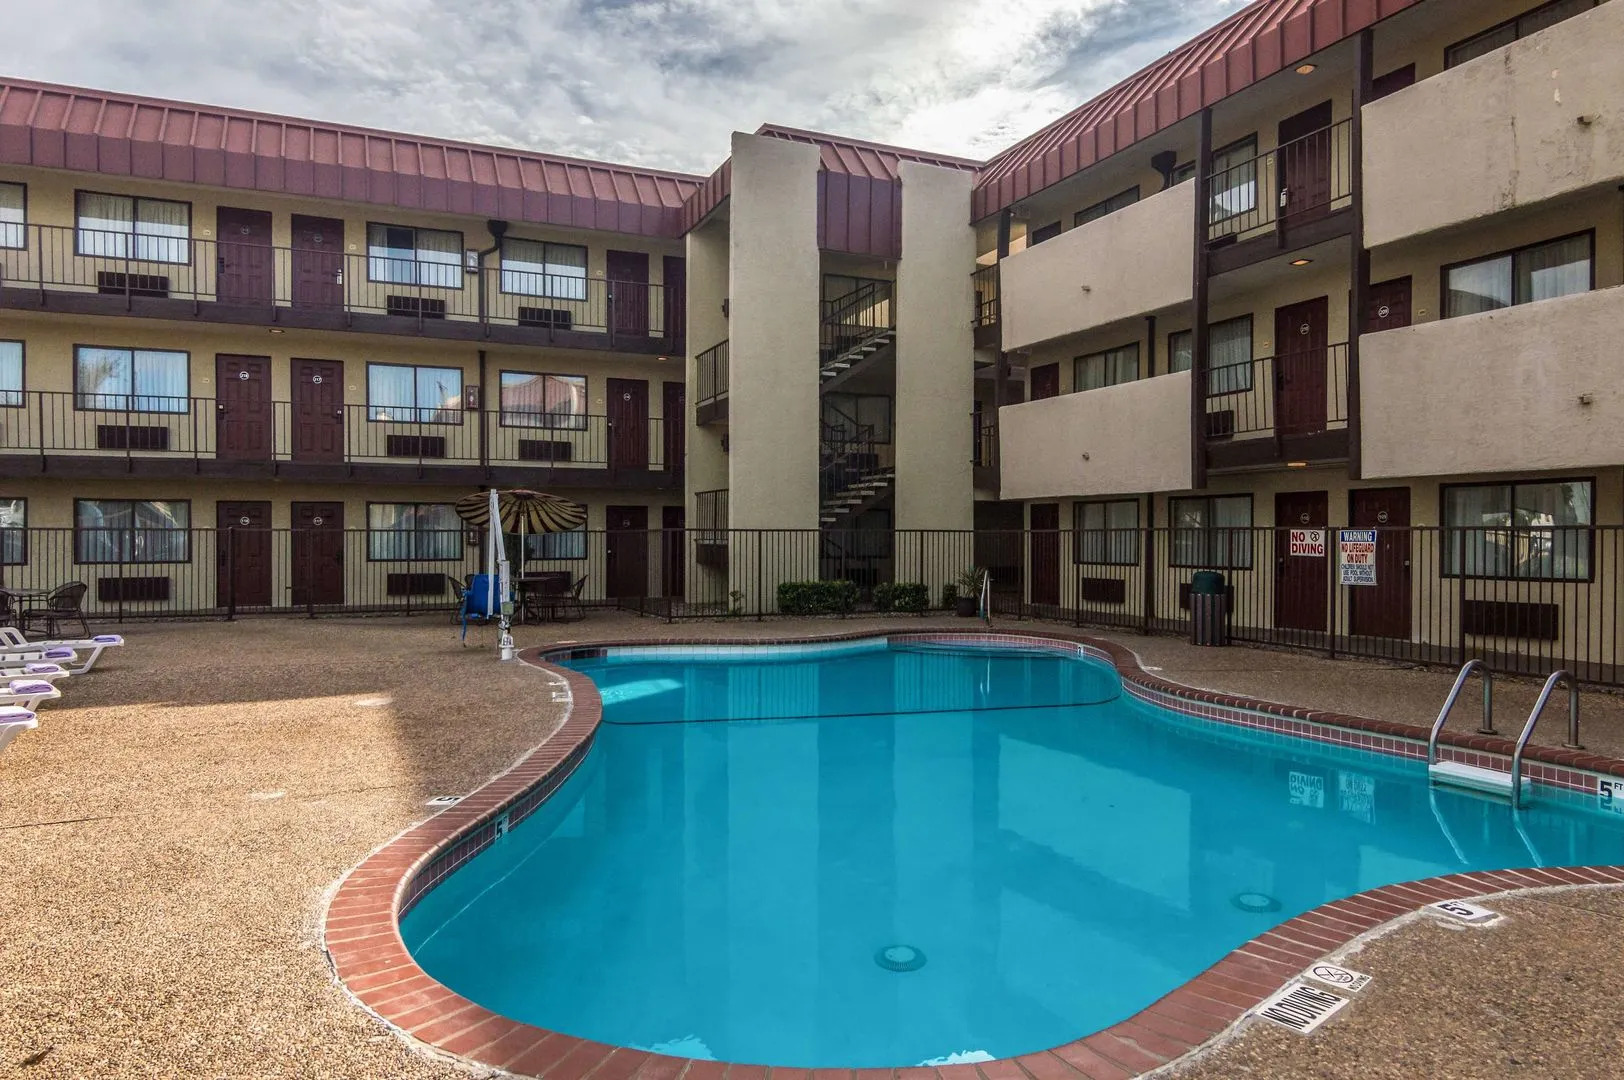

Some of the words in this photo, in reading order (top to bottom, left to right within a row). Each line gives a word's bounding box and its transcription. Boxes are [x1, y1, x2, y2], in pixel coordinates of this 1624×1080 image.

[1292, 532, 1305, 542] NO
[1344, 532, 1373, 541] WARNING
[1292, 544, 1324, 554] DIVING
[1341, 543, 1348, 552] NO
[1349, 543, 1374, 553] LIFEGUARD
[1347, 554, 1354, 563] ON
[1355, 554, 1368, 563] DUTY
[1600, 780, 1612, 798] 5
[1437, 904, 1474, 916] 5
[1275, 986, 1342, 1020] DIVING
[1261, 1007, 1310, 1030] NO
